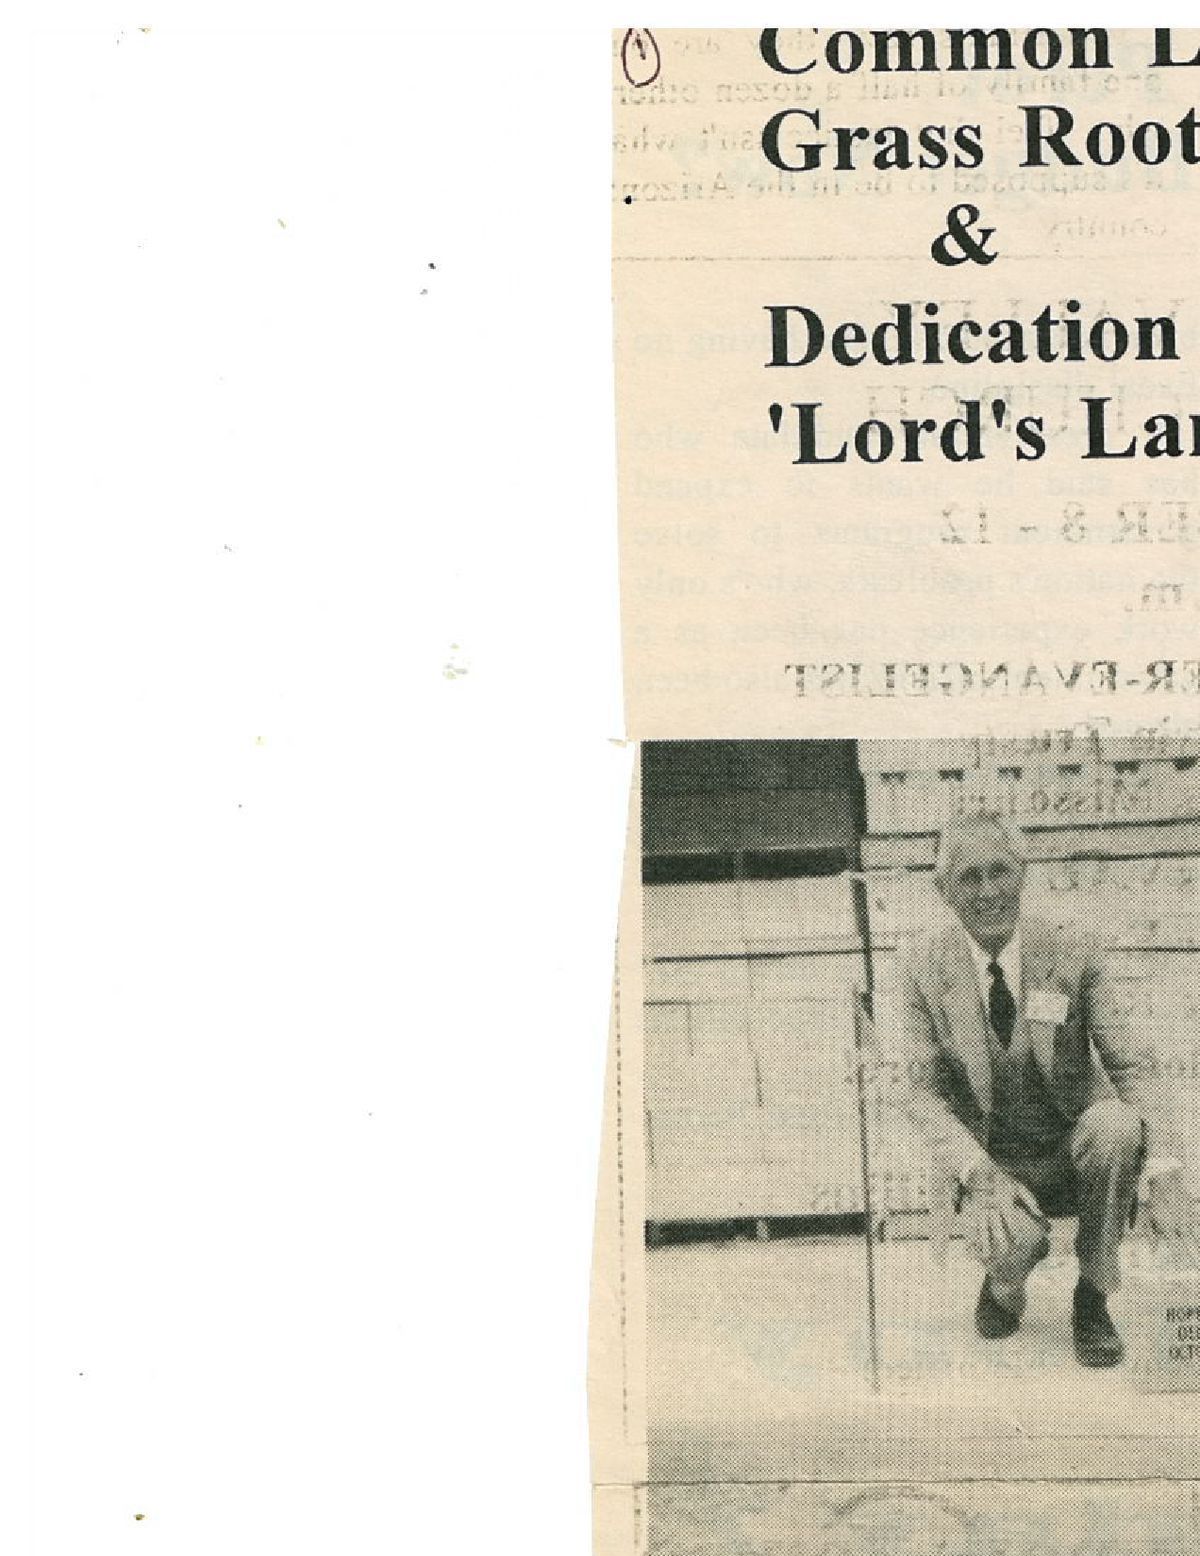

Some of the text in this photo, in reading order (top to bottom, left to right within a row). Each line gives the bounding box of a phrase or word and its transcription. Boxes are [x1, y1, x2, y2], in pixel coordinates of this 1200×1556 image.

[760, 28, 1114, 75] Common
[761, 109, 984, 172] Grass
[931, 203, 998, 267] &
[763, 299, 1181, 367] Dedication
[769, 399, 1046, 465] 'Lord's
